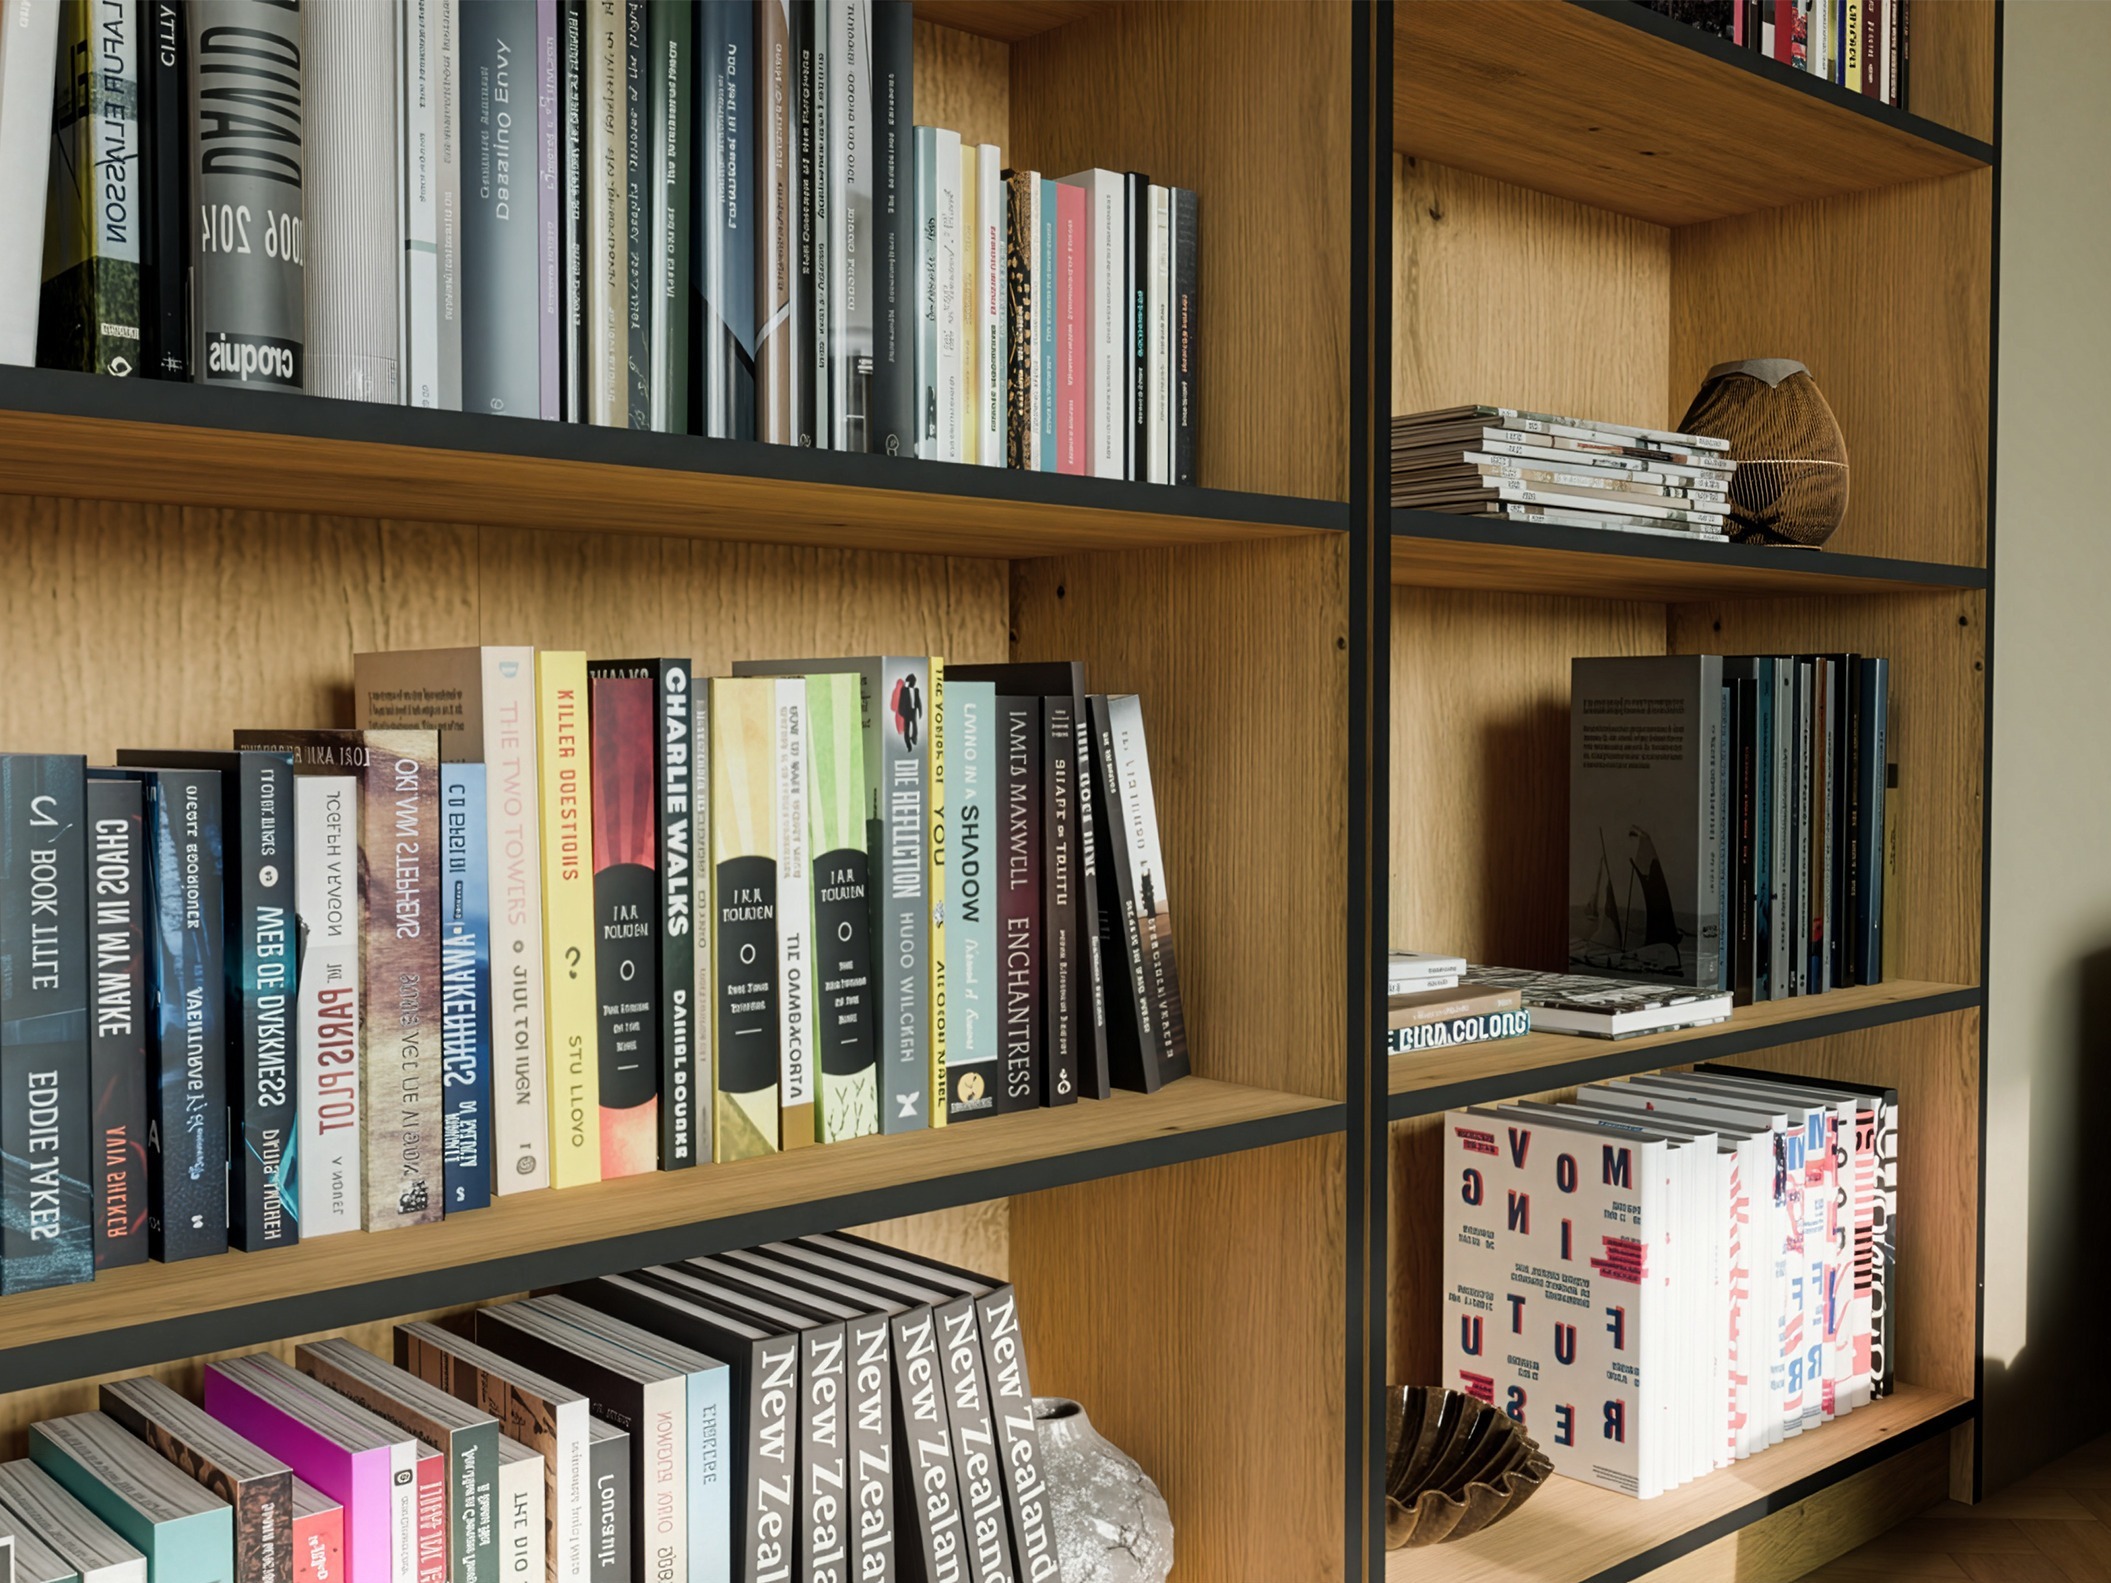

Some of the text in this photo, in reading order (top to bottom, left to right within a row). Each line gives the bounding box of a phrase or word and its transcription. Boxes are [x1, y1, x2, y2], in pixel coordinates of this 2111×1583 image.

[666, 666, 689, 938] CHARLIE WALKS
[1007, 917, 1031, 1098] ENCHANTRESS
[758, 1345, 795, 1464] New
[810, 1331, 845, 1449] New
[855, 1321, 888, 1435] New
[901, 1313, 939, 1423] New
[943, 1304, 981, 1411] New
[984, 1294, 1024, 1399] New
